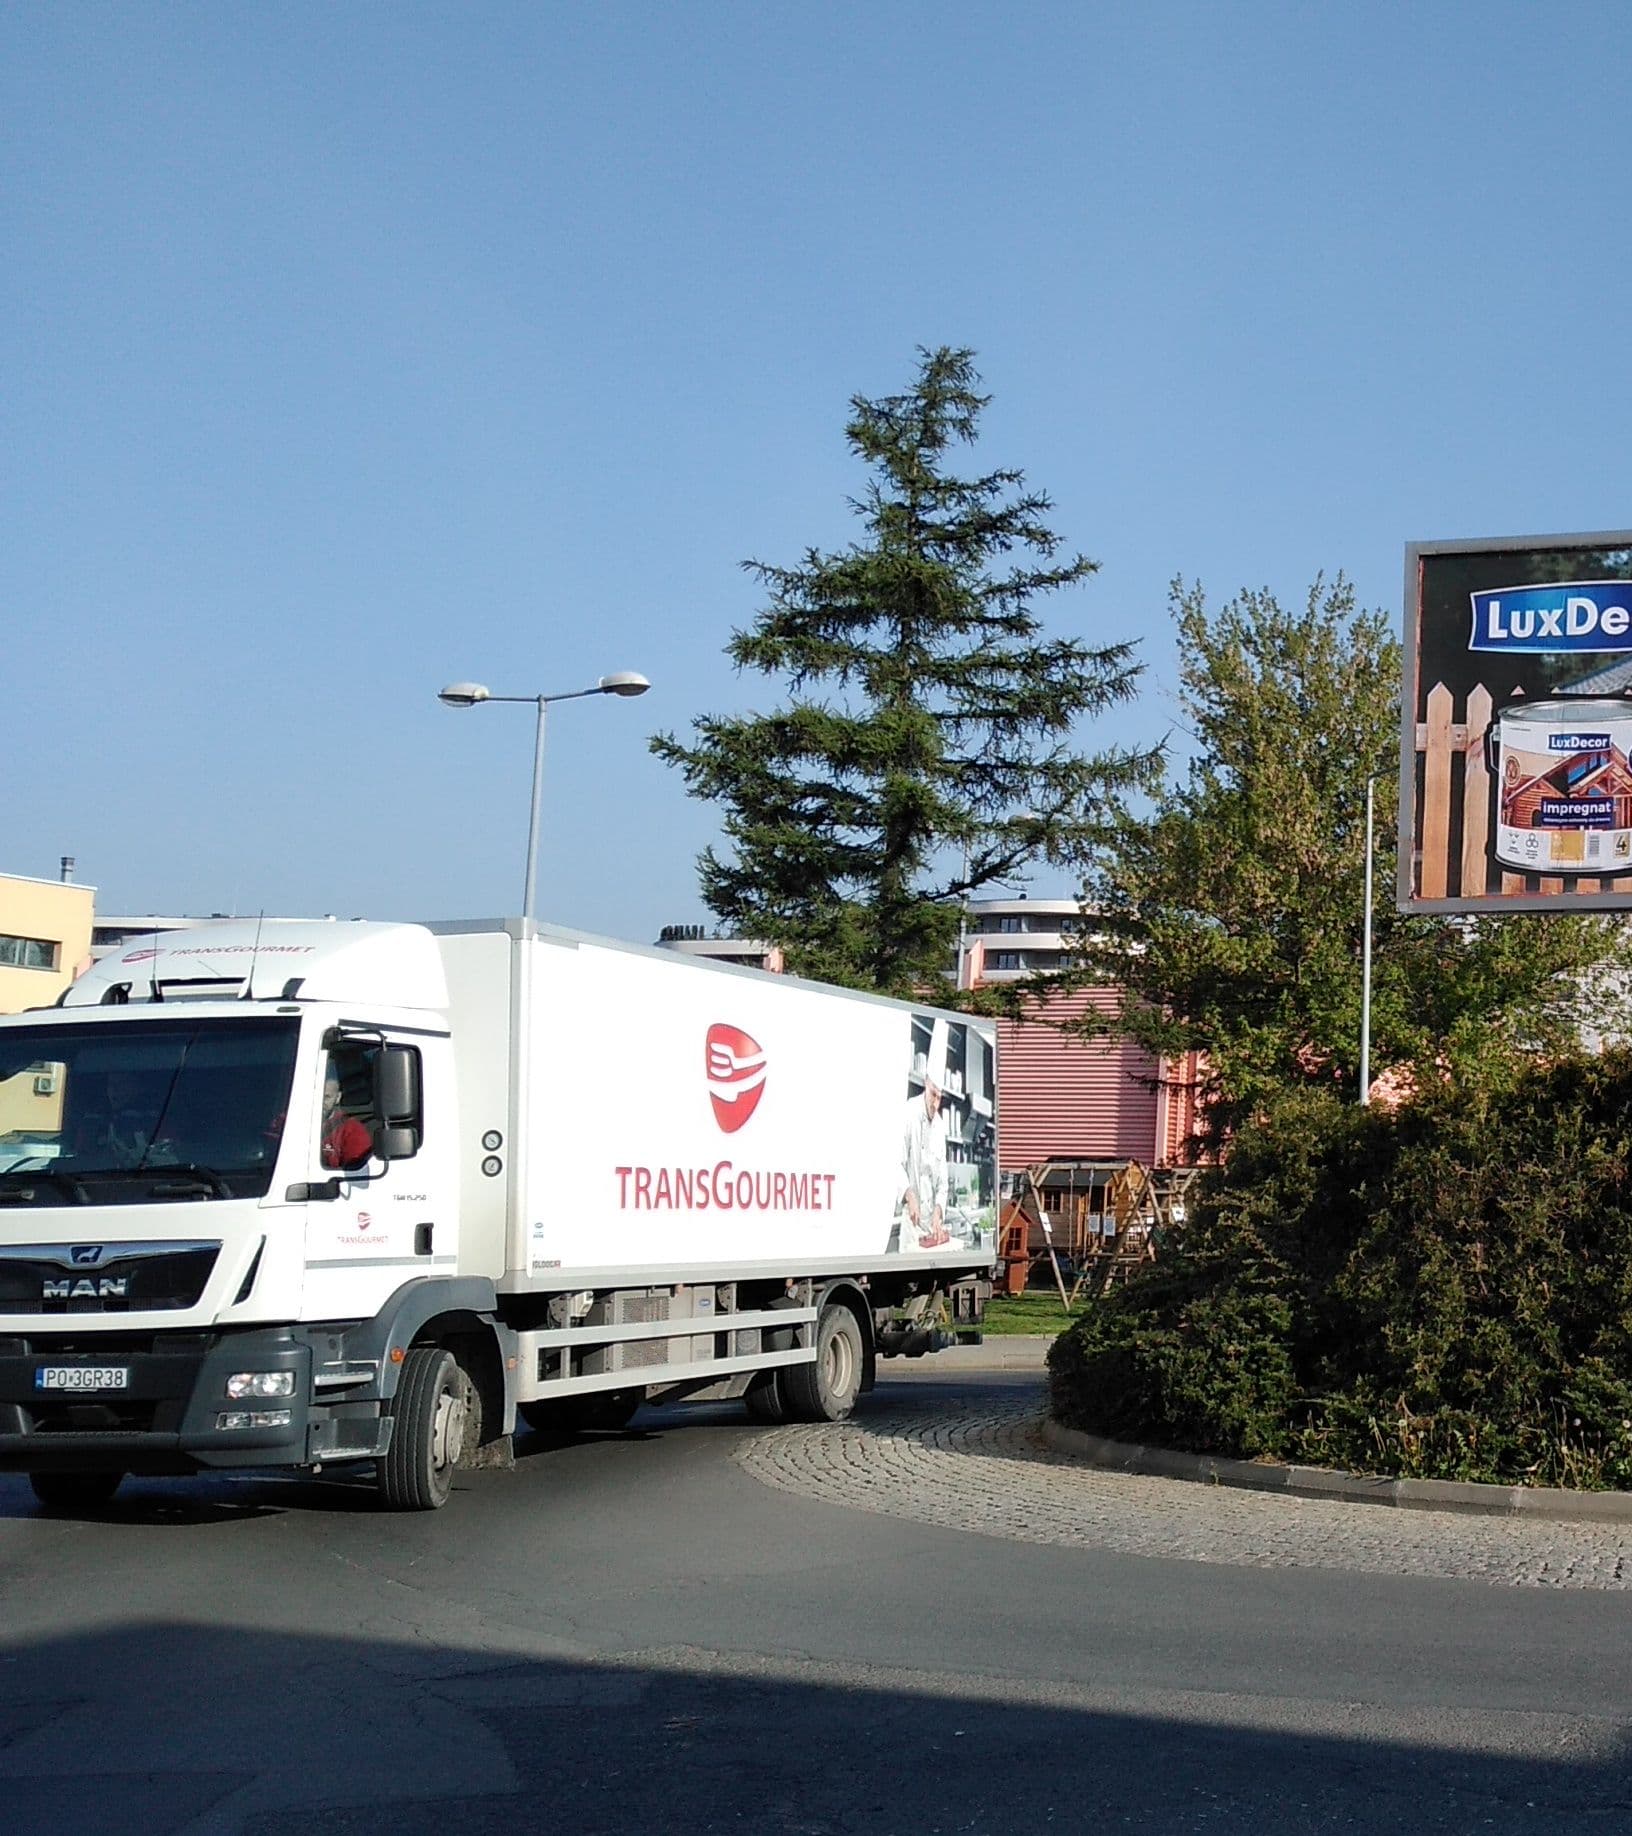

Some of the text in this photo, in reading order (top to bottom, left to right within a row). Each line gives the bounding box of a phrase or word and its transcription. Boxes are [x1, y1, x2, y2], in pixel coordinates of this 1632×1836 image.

[1551, 736, 1608, 748] LuxDecor
[1543, 801, 1612, 816] impregnat
[615, 1160, 836, 1211] TRANSGOURMET
[43, 1278, 127, 1298] MAN
[46, 1369, 124, 1387] PO 3GR38
